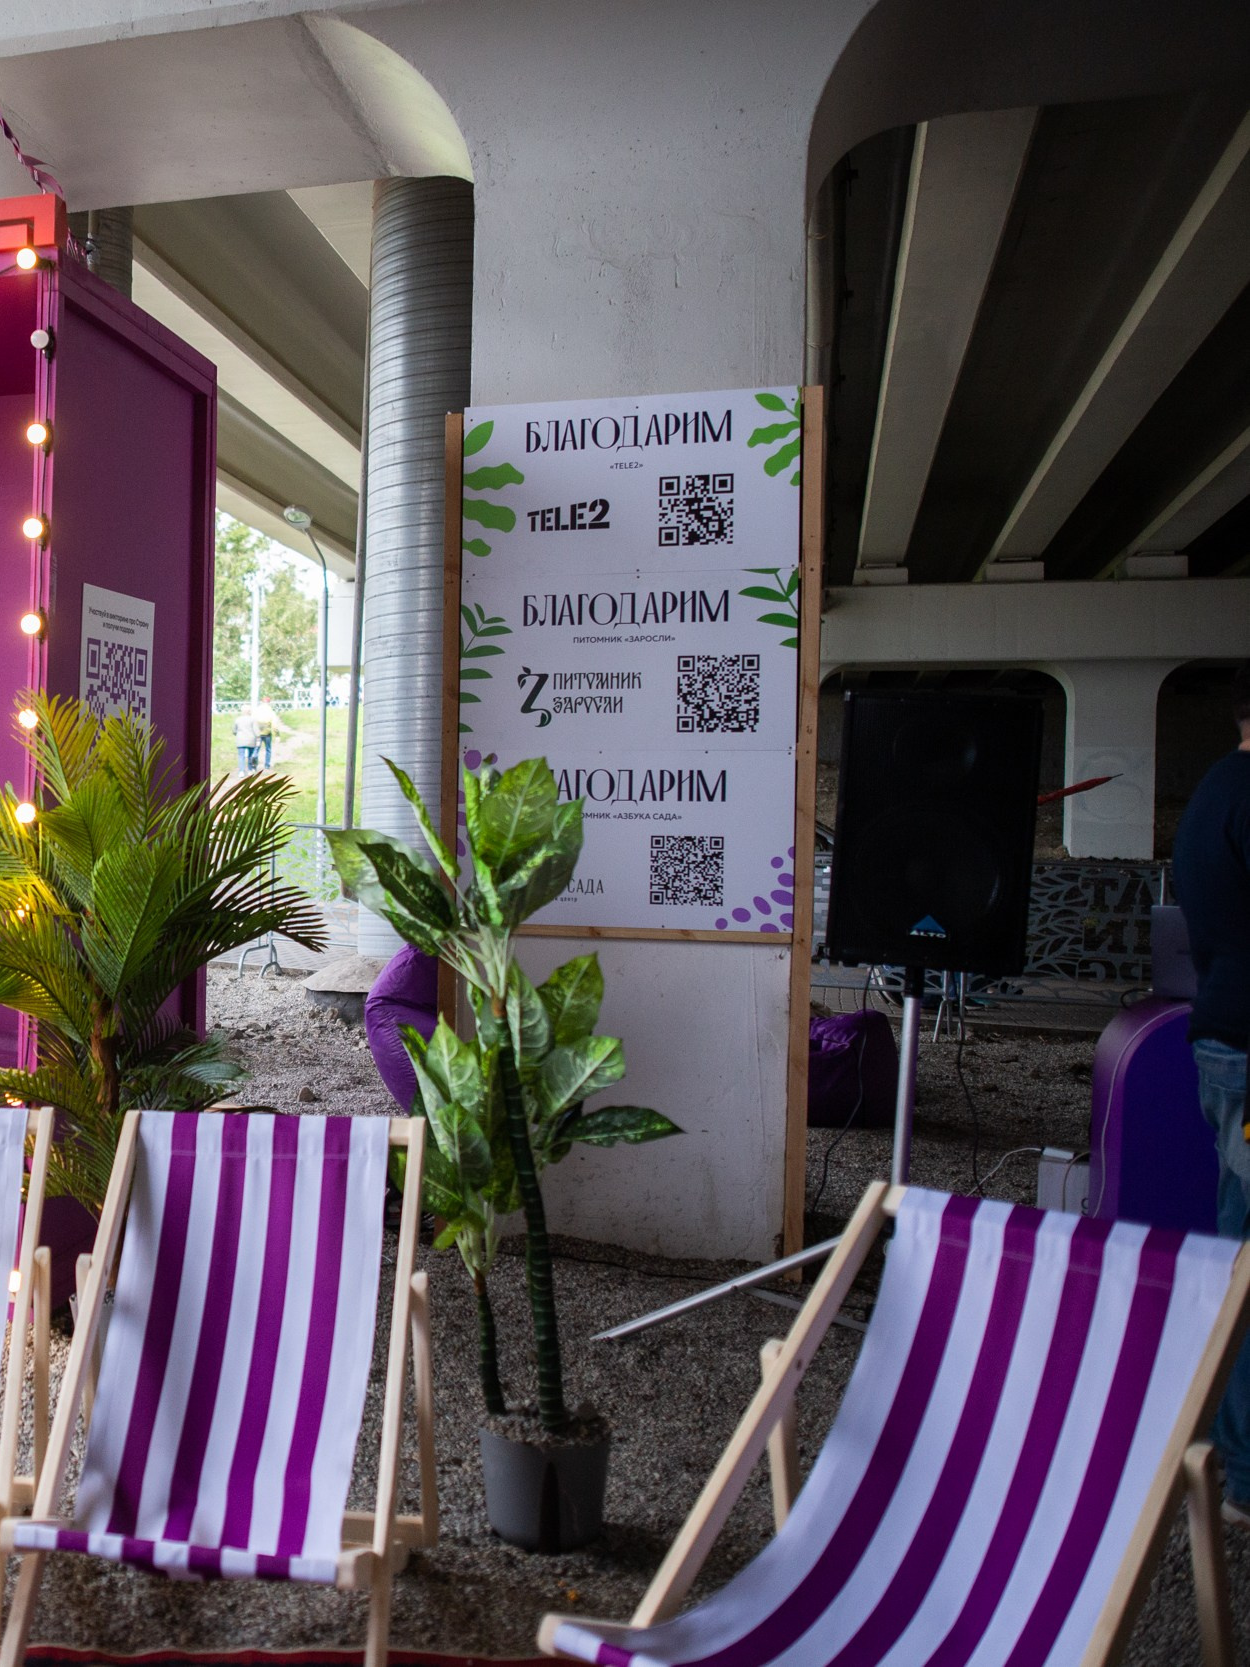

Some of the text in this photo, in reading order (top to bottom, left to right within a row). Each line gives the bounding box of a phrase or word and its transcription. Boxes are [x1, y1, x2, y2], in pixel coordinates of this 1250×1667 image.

[525, 409, 732, 453] БЛАГОДАРИМ
[609, 461, 644, 470] «TELE2»
[526, 498, 611, 532] TELE2
[523, 589, 730, 629] БЛАГОДАРИМ
[573, 634, 676, 644] ПИТОМНИК «ЗАРОСЛИ»
[552, 672, 642, 690] ПИТОМНИК
[552, 696, 623, 714] ЗАРОСЛИ
[551, 769, 727, 806] АГОДАРИМ
[613, 812, 651, 820] «АЗБУКА
[652, 813, 682, 822] САДА»
[566, 878, 604, 894] САДА
[909, 930, 947, 938] ALTO
